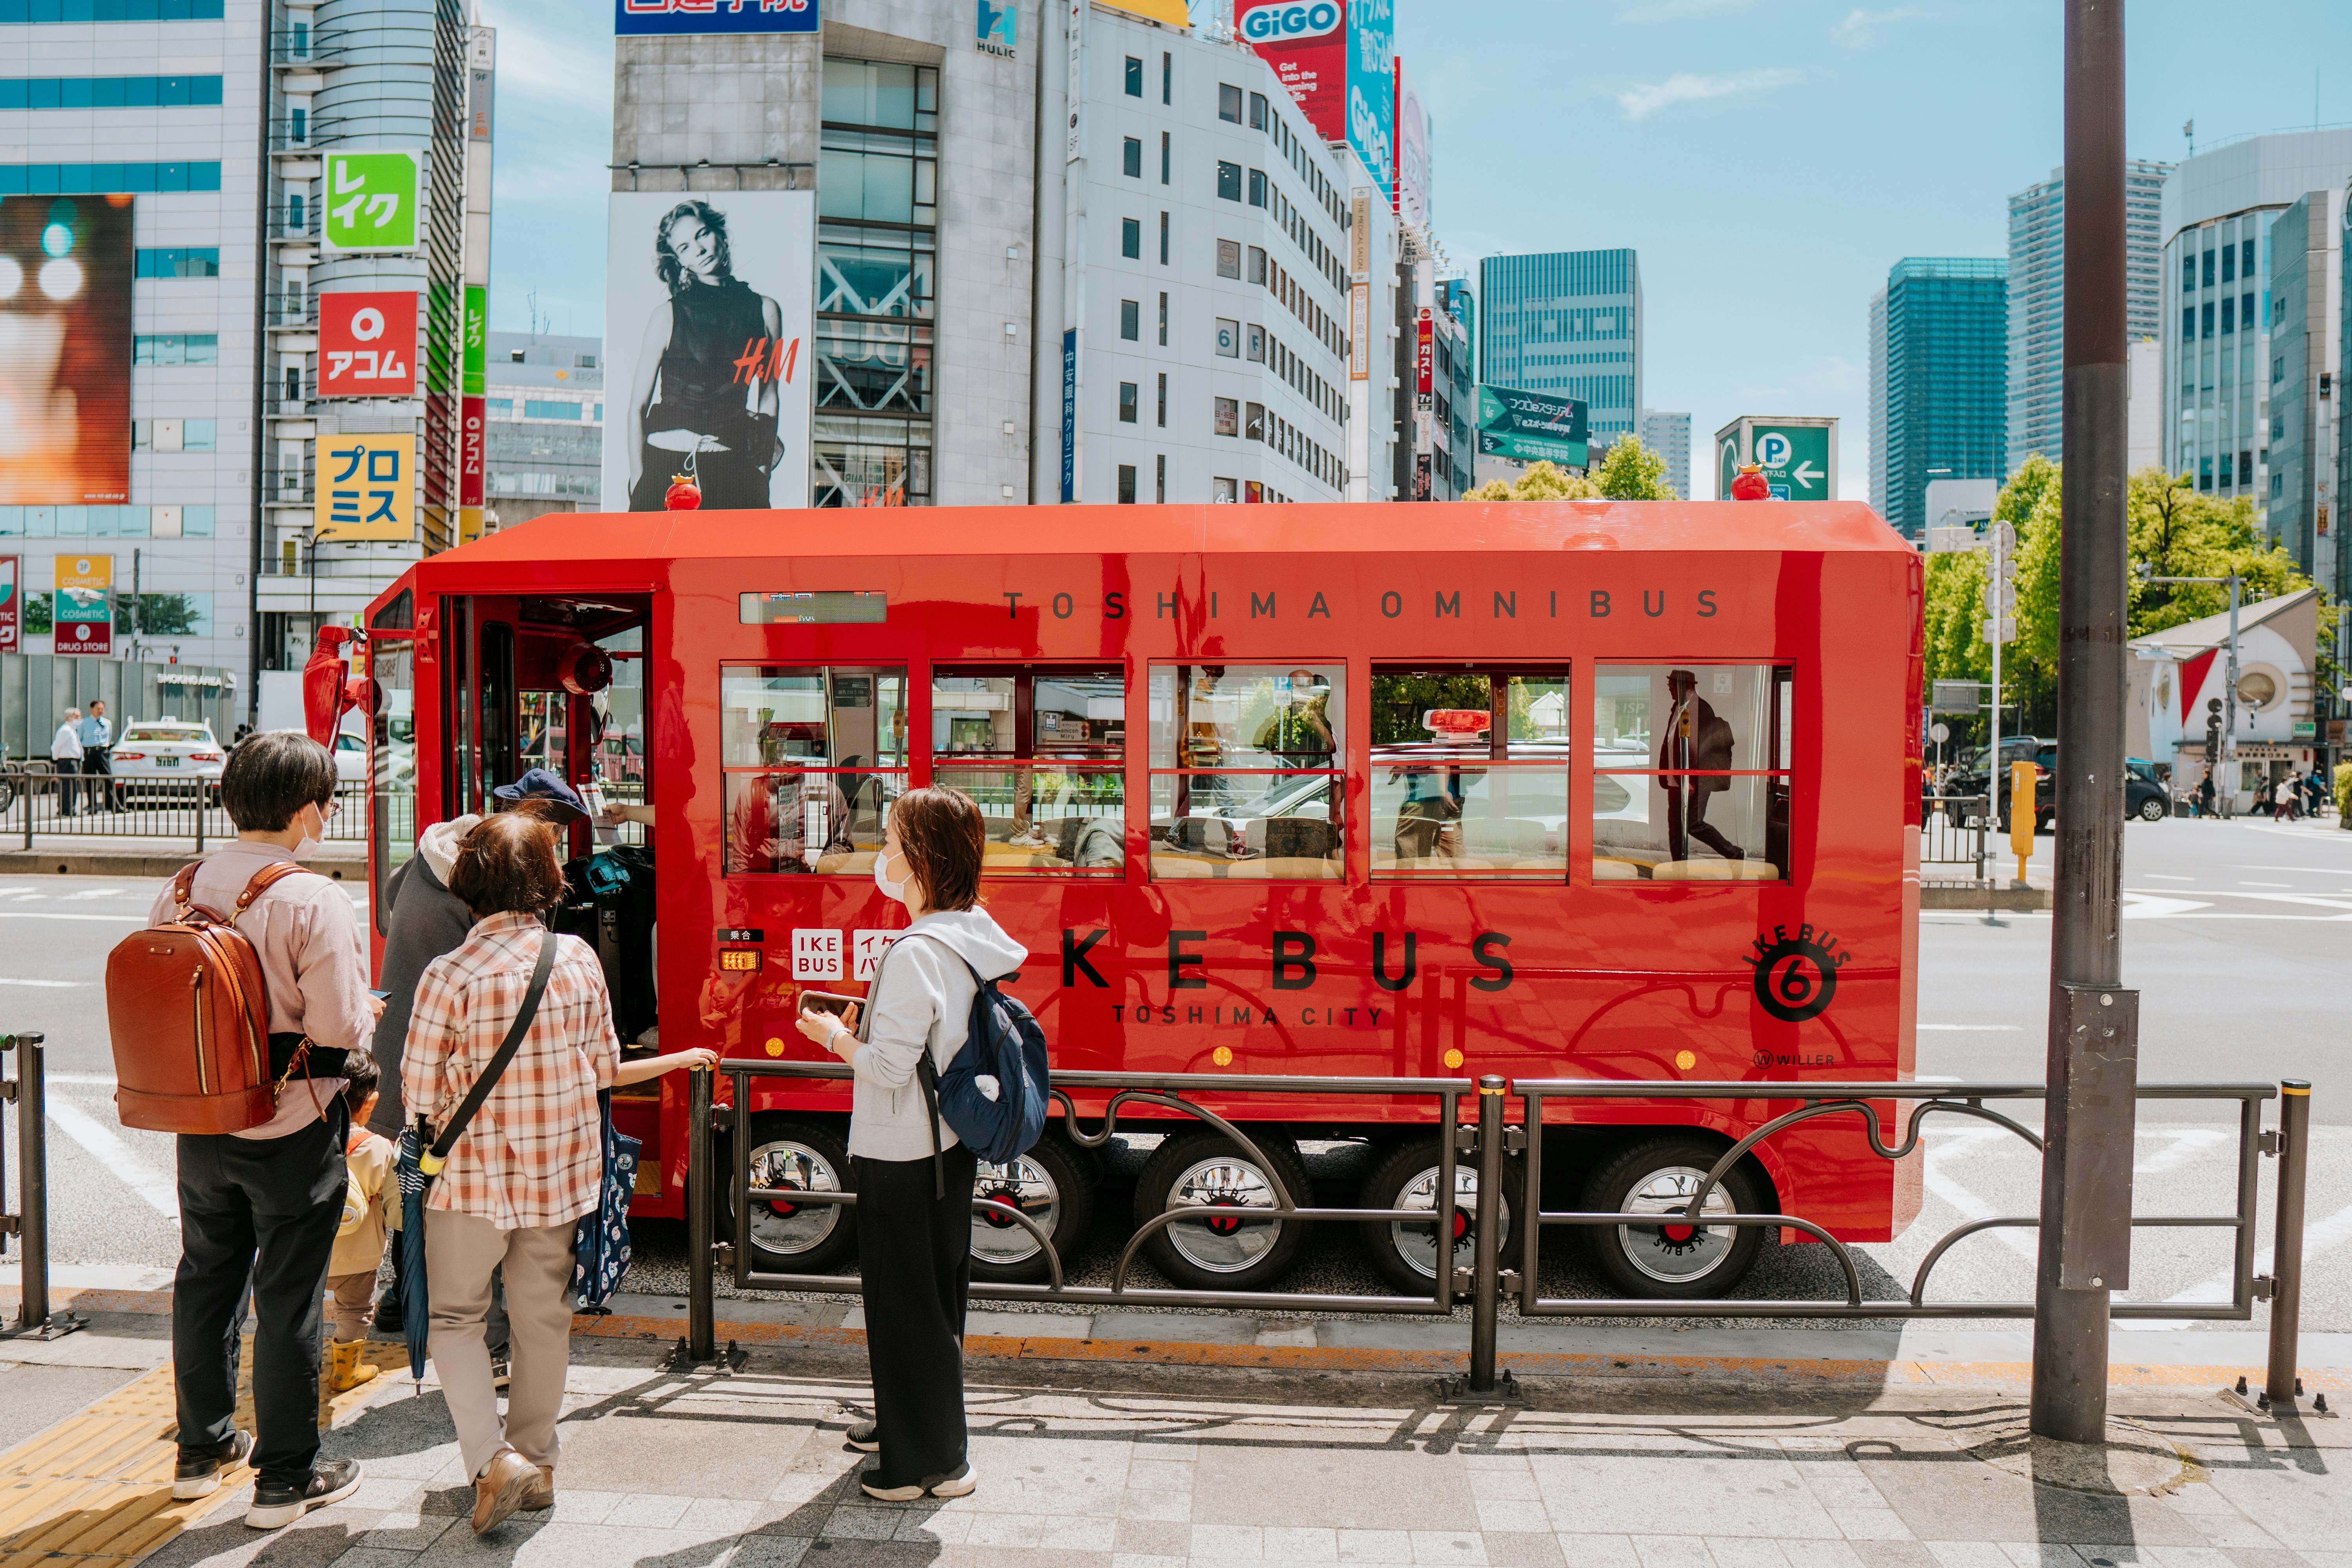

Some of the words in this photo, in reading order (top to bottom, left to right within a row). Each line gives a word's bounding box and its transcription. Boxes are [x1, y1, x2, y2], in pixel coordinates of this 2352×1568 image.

[1246, 4, 1335, 38] GiGO
[977, 42, 1015, 59] HULIC
[1279, 62, 1297, 71] Get
[1282, 73, 1300, 82] into
[1301, 71, 1317, 80] the
[1282, 82, 1317, 91] aming
[466, 309, 482, 348] レイク
[1218, 329, 1230, 348] 6
[327, 350, 407, 380] アコム
[733, 337, 800, 385] H&M
[1420, 343, 1431, 379] ガスト
[1419, 394, 1431, 403] 7F
[1064, 350, 1074, 485] 中安眼科クリニック
[465, 433, 480, 475] アコム
[1766, 439, 1784, 463] P
[79, 563, 89, 572] 3F
[62, 577, 105, 586] COSMETIC
[1003, 592, 1331, 619] TOSHIMA
[1381, 590, 1717, 618] OMNIBUS
[62, 609, 105, 619] COSMETIC
[79, 628, 87, 637] 1F
[57, 642, 81, 652] DRUG
[82, 642, 109, 652] STORE
[157, 673, 198, 686] SMOKING
[199, 676, 222, 687] AREA
[730, 931, 751, 940] 乗合
[801, 937, 837, 952] IKE
[799, 958, 837, 973] BUS
[1780, 960, 1811, 1002] 6
[1112, 1005, 1279, 1025] TOSHIMA
[1302, 1007, 1383, 1026] CITY
[1777, 1054, 1834, 1065] WILLER
